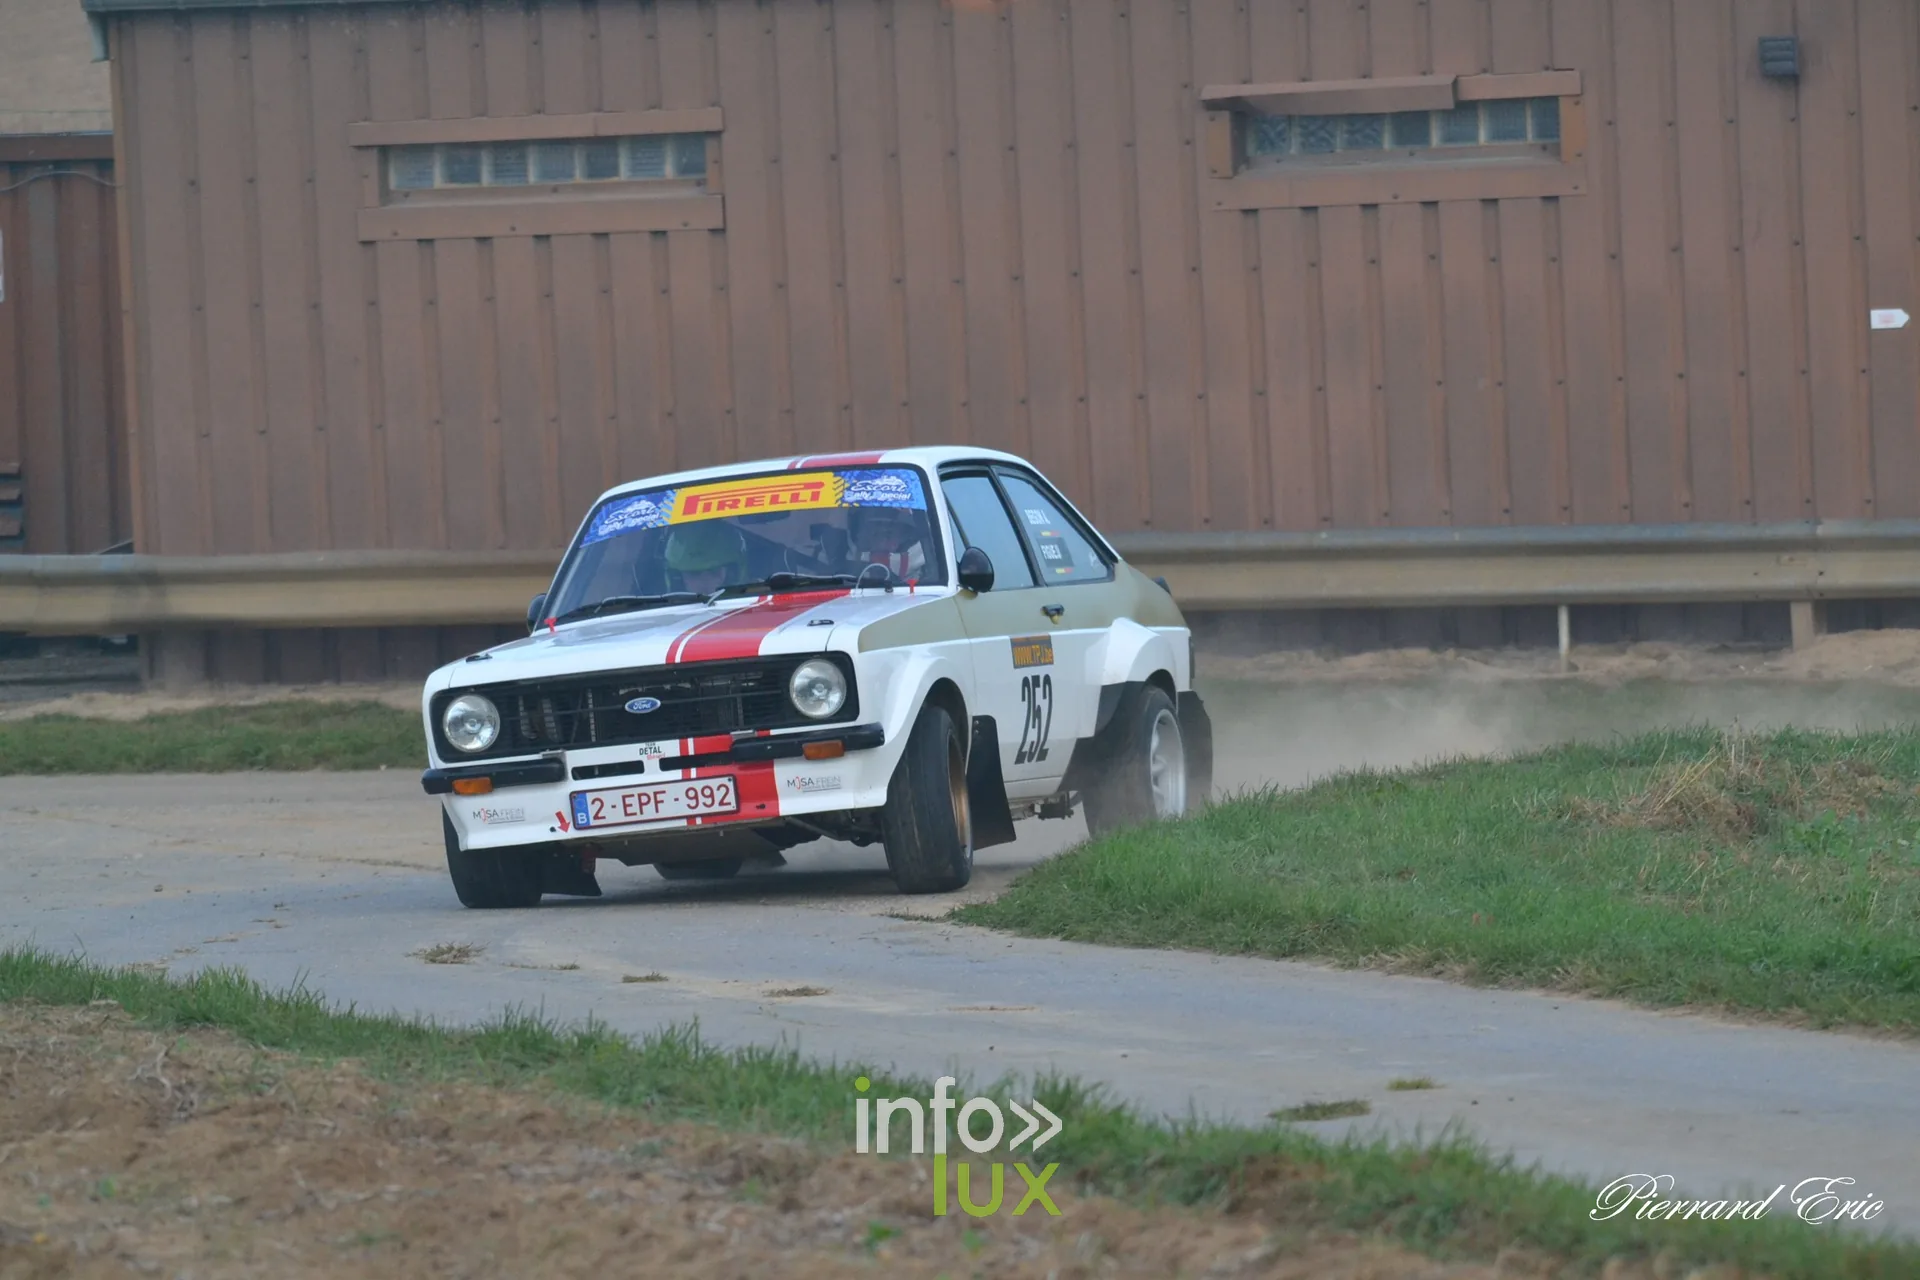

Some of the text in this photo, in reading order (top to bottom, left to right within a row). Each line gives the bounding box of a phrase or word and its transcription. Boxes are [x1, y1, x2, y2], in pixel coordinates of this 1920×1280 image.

[682, 481, 825, 516] PIRELLI
[632, 701, 652, 710] Ford
[1014, 673, 1053, 765] 252
[639, 746, 662, 756] DETAL
[577, 812, 588, 824] B
